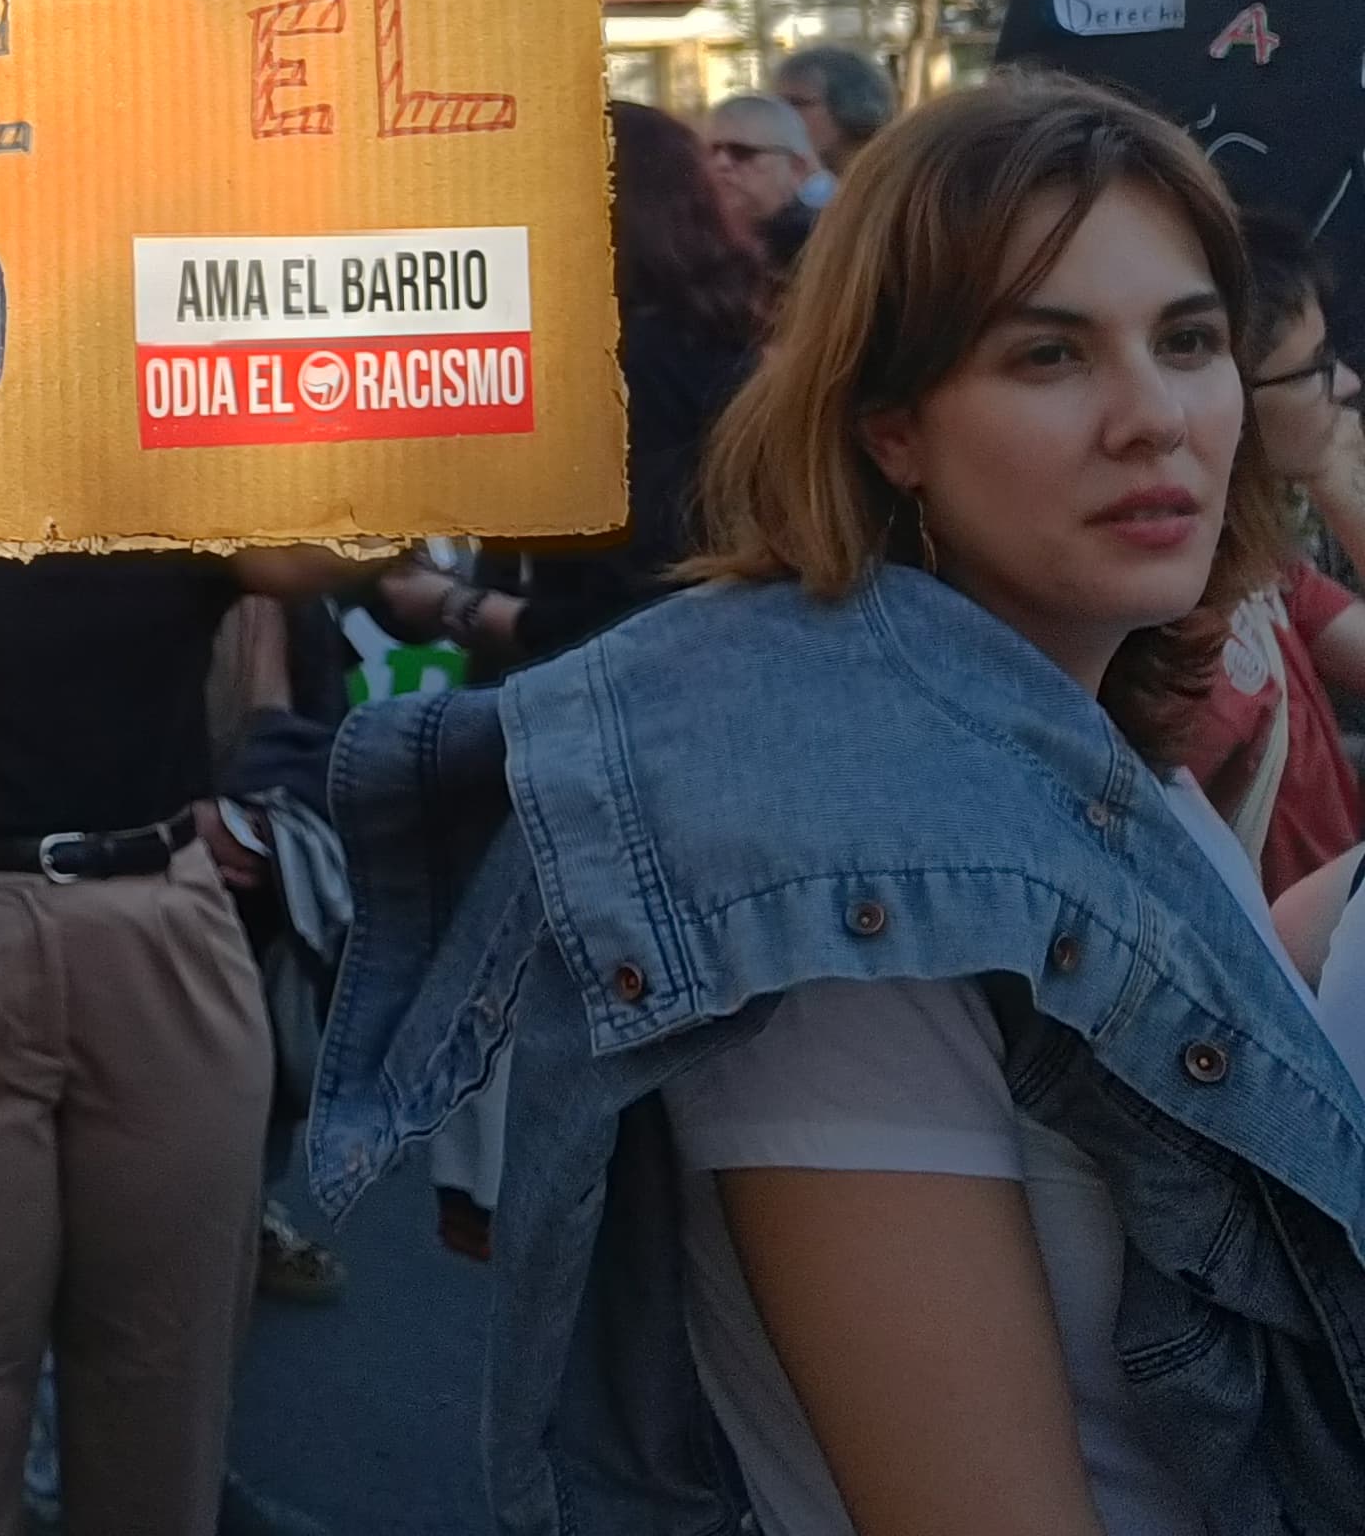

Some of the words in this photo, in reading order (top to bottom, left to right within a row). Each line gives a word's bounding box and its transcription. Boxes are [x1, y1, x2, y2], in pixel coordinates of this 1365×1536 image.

[1209, 1, 1280, 66] A
[176, 259, 268, 322] AMA
[282, 256, 329, 318] EL
[341, 248, 489, 314] BARRIO
[145, 356, 238, 419] ODIA
[248, 354, 295, 414] EL
[354, 346, 526, 411] RACISMO
